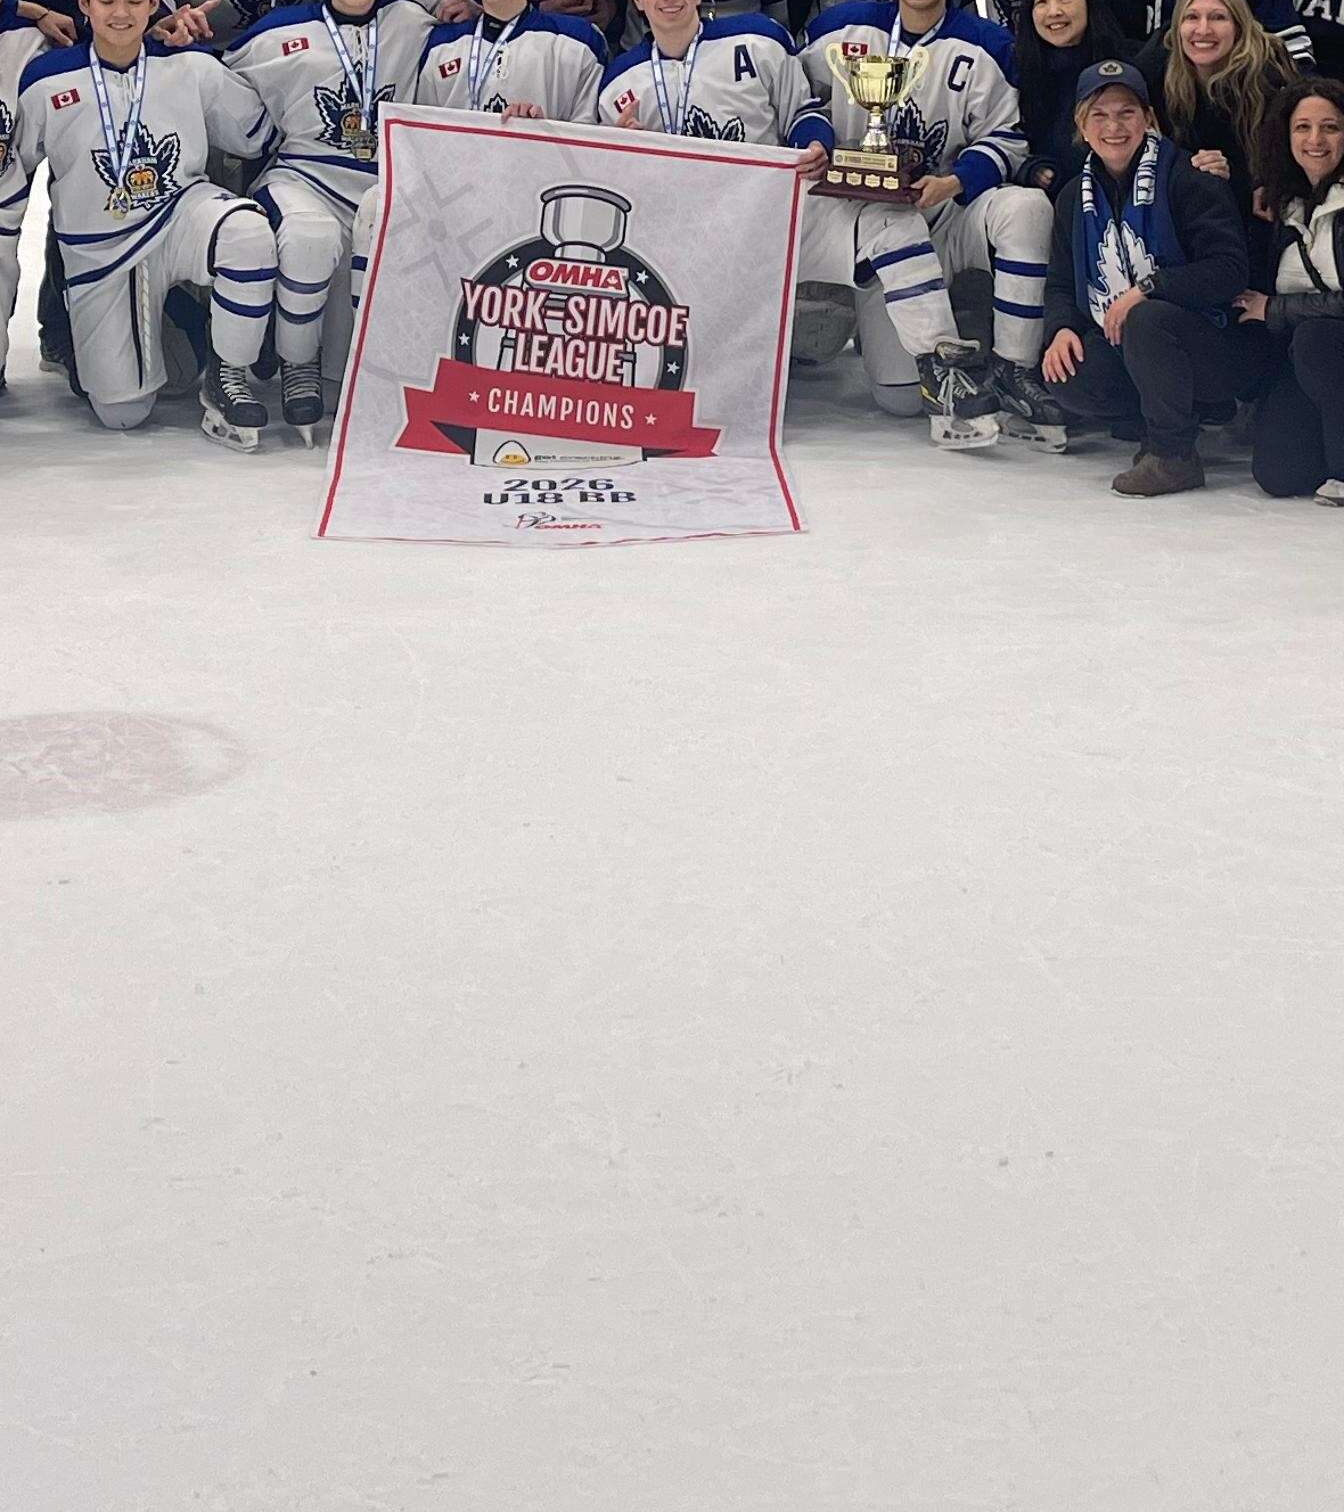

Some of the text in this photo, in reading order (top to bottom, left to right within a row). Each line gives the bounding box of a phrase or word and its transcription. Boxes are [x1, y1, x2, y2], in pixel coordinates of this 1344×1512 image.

[734, 44, 757, 82] A
[947, 54, 975, 93] C
[529, 261, 624, 291] OMHA
[461, 278, 689, 348] YORK-SIMCOE
[514, 332, 625, 384] LEAGUE
[487, 387, 634, 430] CHAMPIONS
[483, 490, 637, 505] U18 BB
[503, 477, 615, 492] 2026
